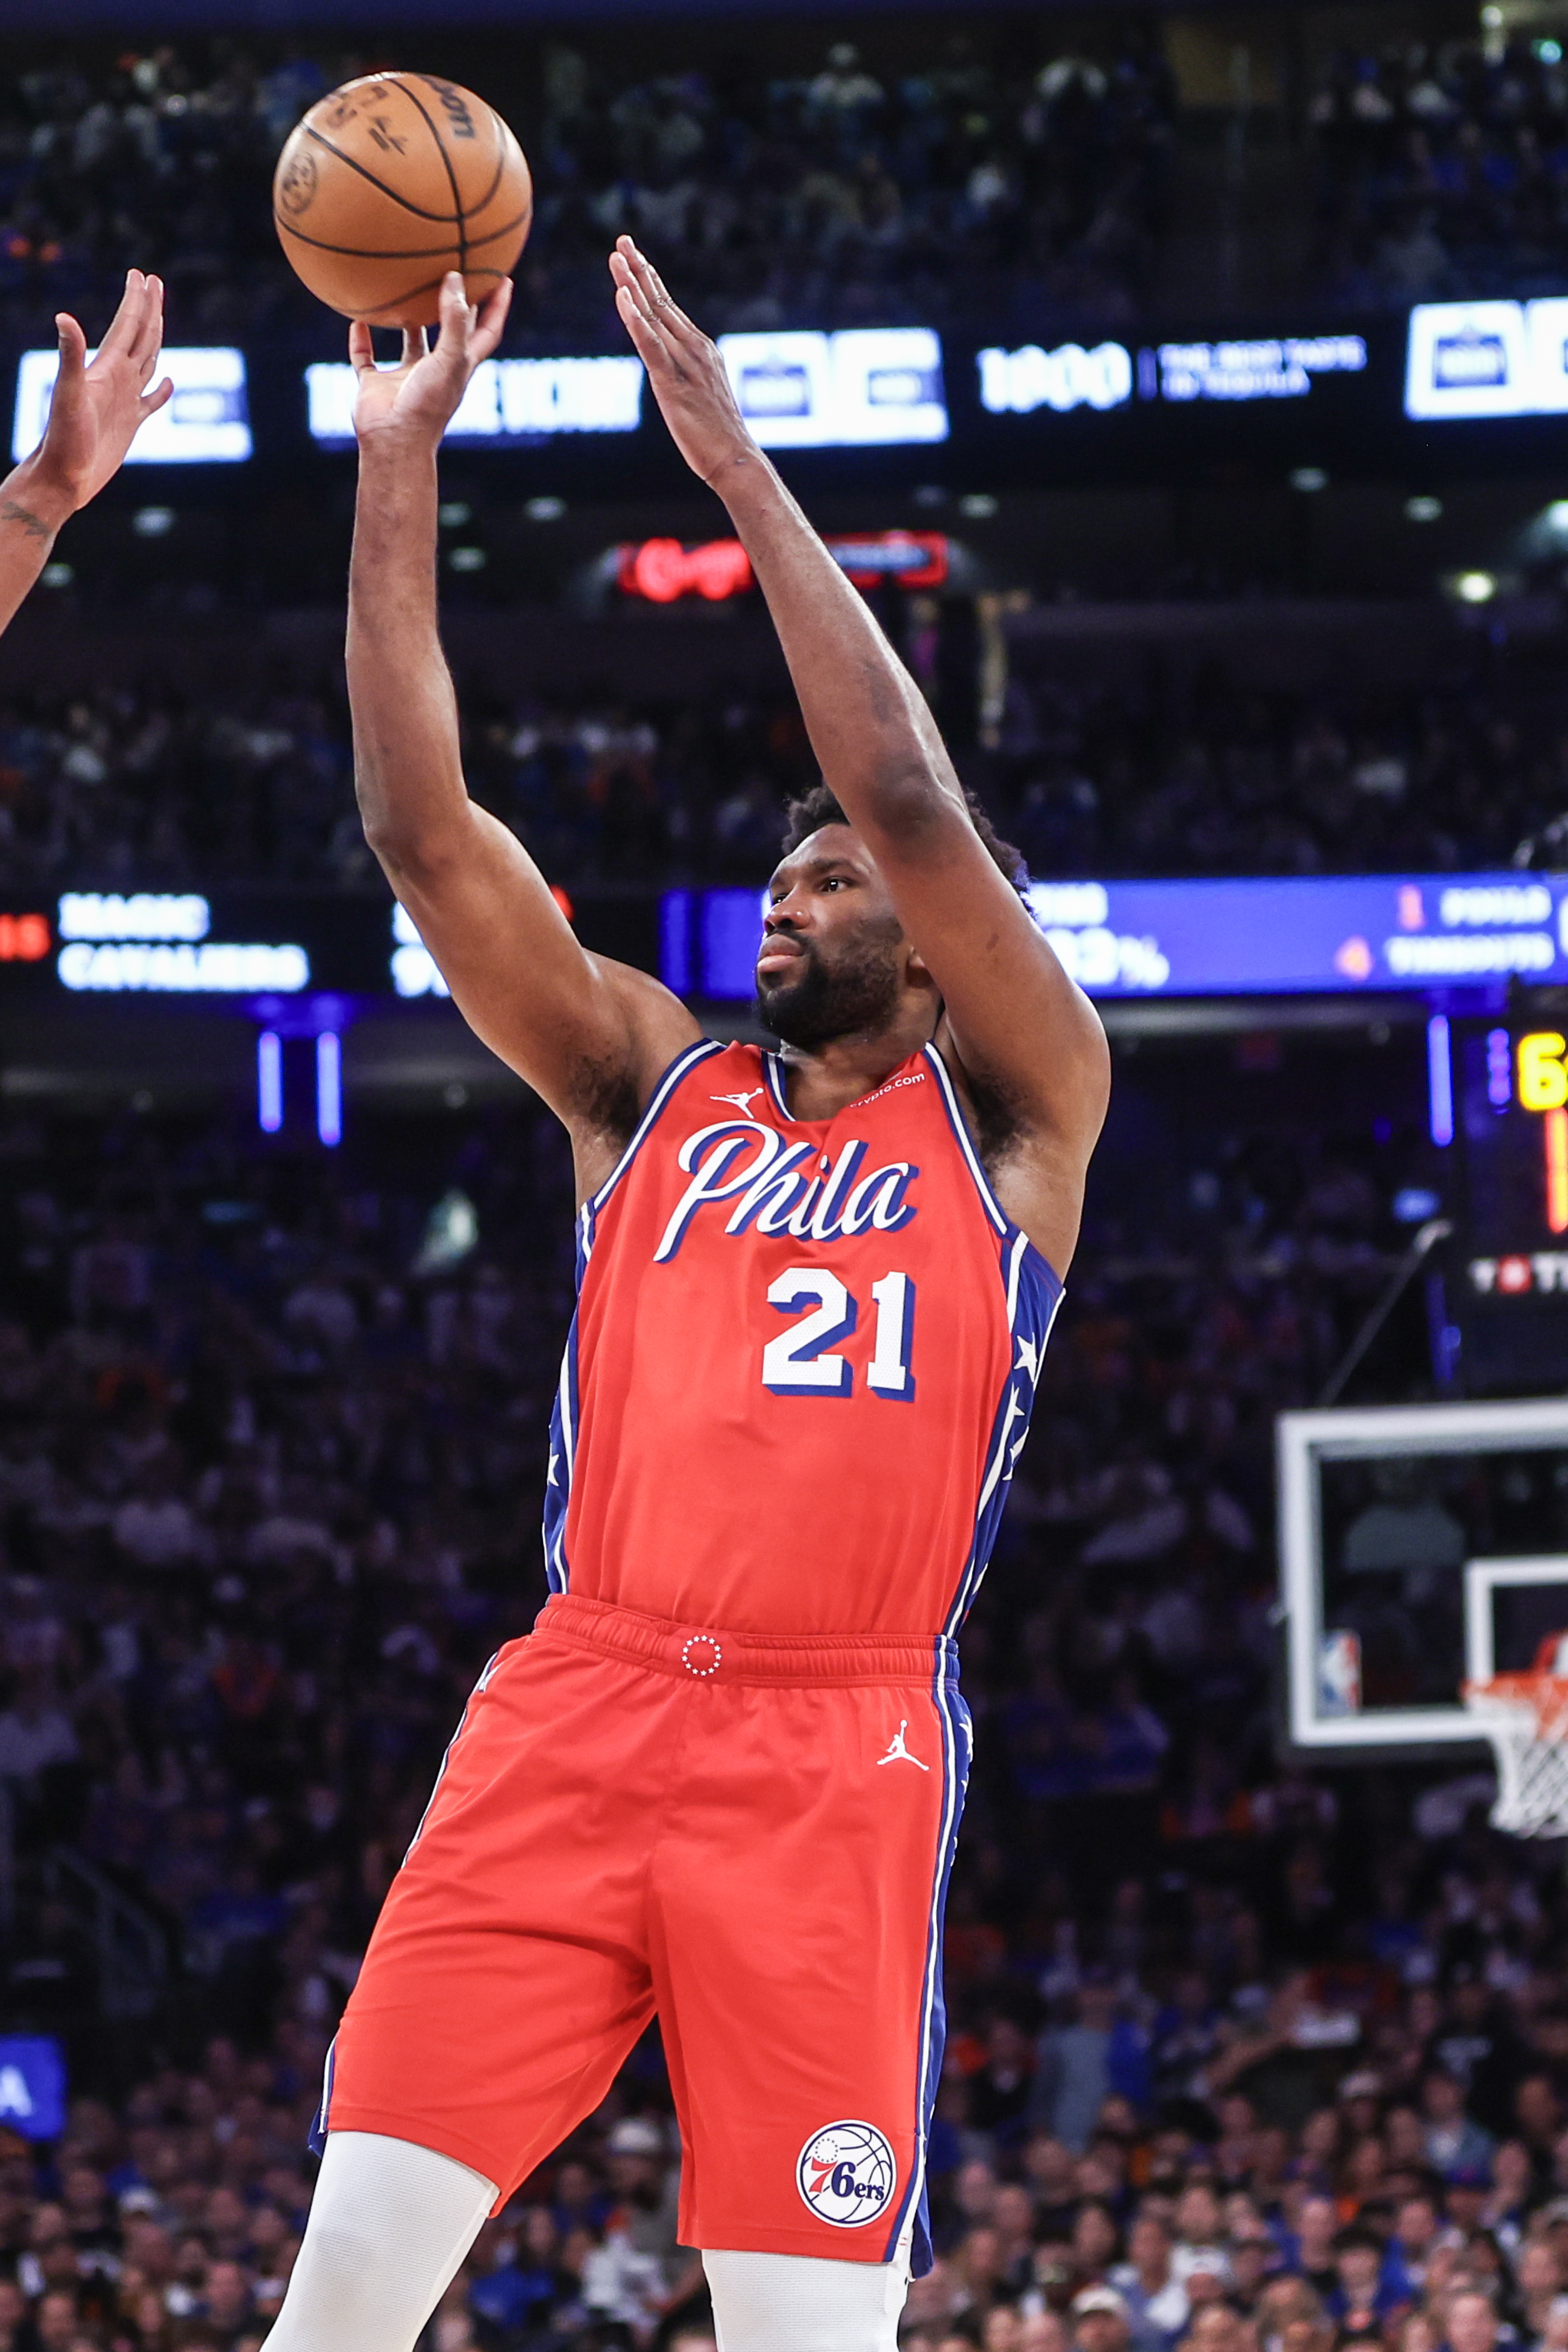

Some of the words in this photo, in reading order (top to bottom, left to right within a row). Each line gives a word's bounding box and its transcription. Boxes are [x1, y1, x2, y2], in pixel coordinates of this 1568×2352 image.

[1517, 1032, 1568, 1112] 6
[652, 1119, 919, 1264] Phila
[762, 1267, 916, 1402] 21
[809, 2157, 885, 2201] 76ers
